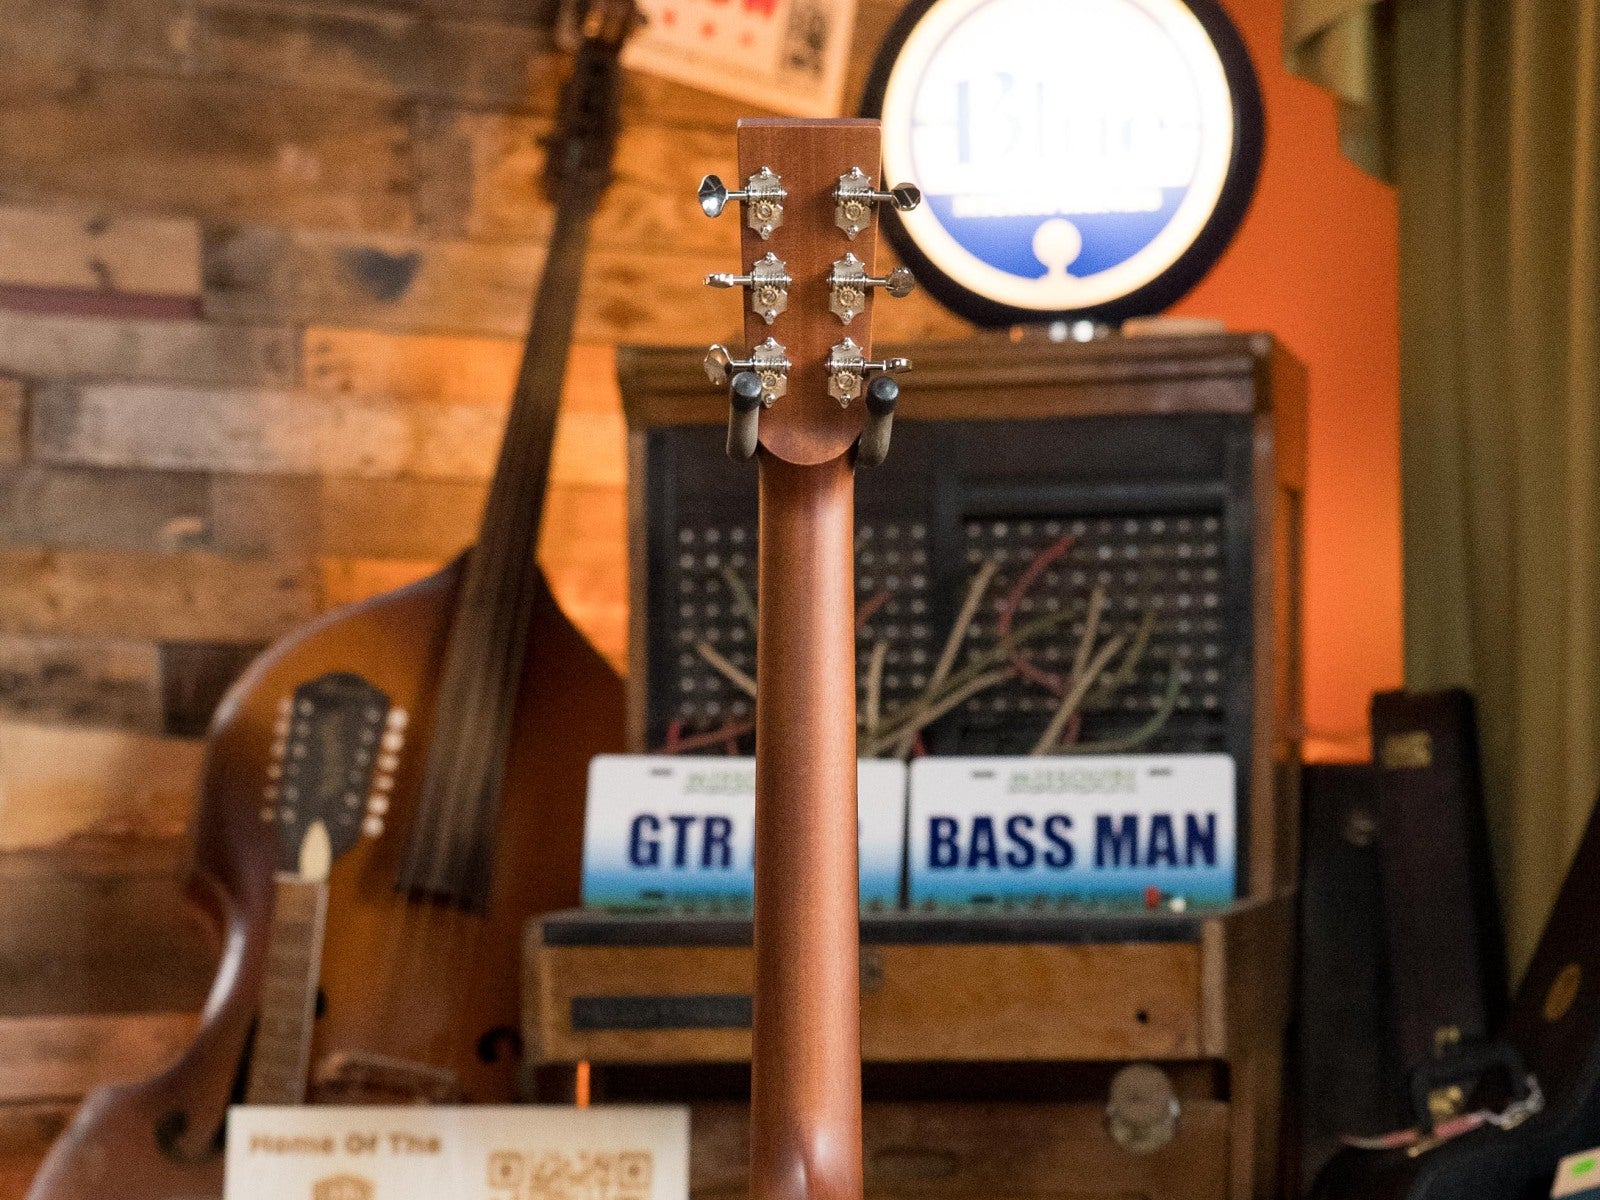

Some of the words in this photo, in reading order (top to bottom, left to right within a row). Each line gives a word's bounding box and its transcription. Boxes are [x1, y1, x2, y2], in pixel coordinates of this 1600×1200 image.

[629, 813, 734, 868] GTR
[928, 814, 1075, 869] BASS
[1093, 812, 1217, 868] MAN
[250, 1131, 333, 1155] Home
[344, 1131, 378, 1155] Of
[388, 1130, 441, 1154] The
